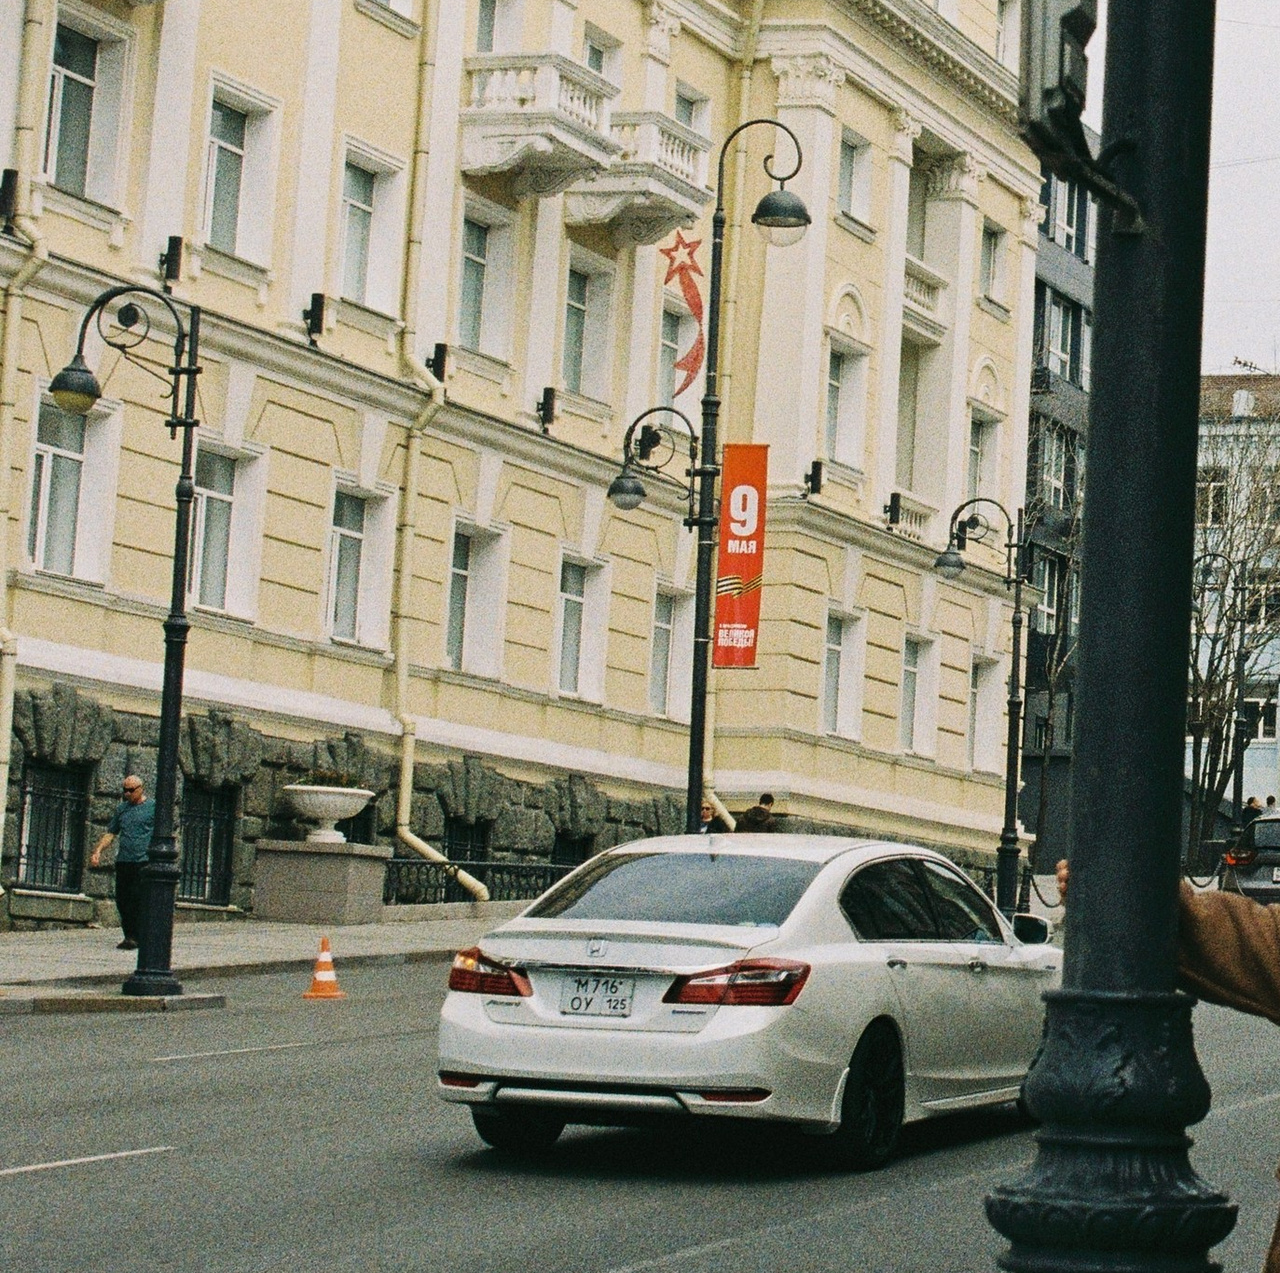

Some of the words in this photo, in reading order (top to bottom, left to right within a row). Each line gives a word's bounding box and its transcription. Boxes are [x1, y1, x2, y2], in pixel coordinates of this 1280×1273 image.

[730, 484, 759, 537] 9
[727, 539, 757, 554] МАЯ
[606, 998, 627, 1010] 125
